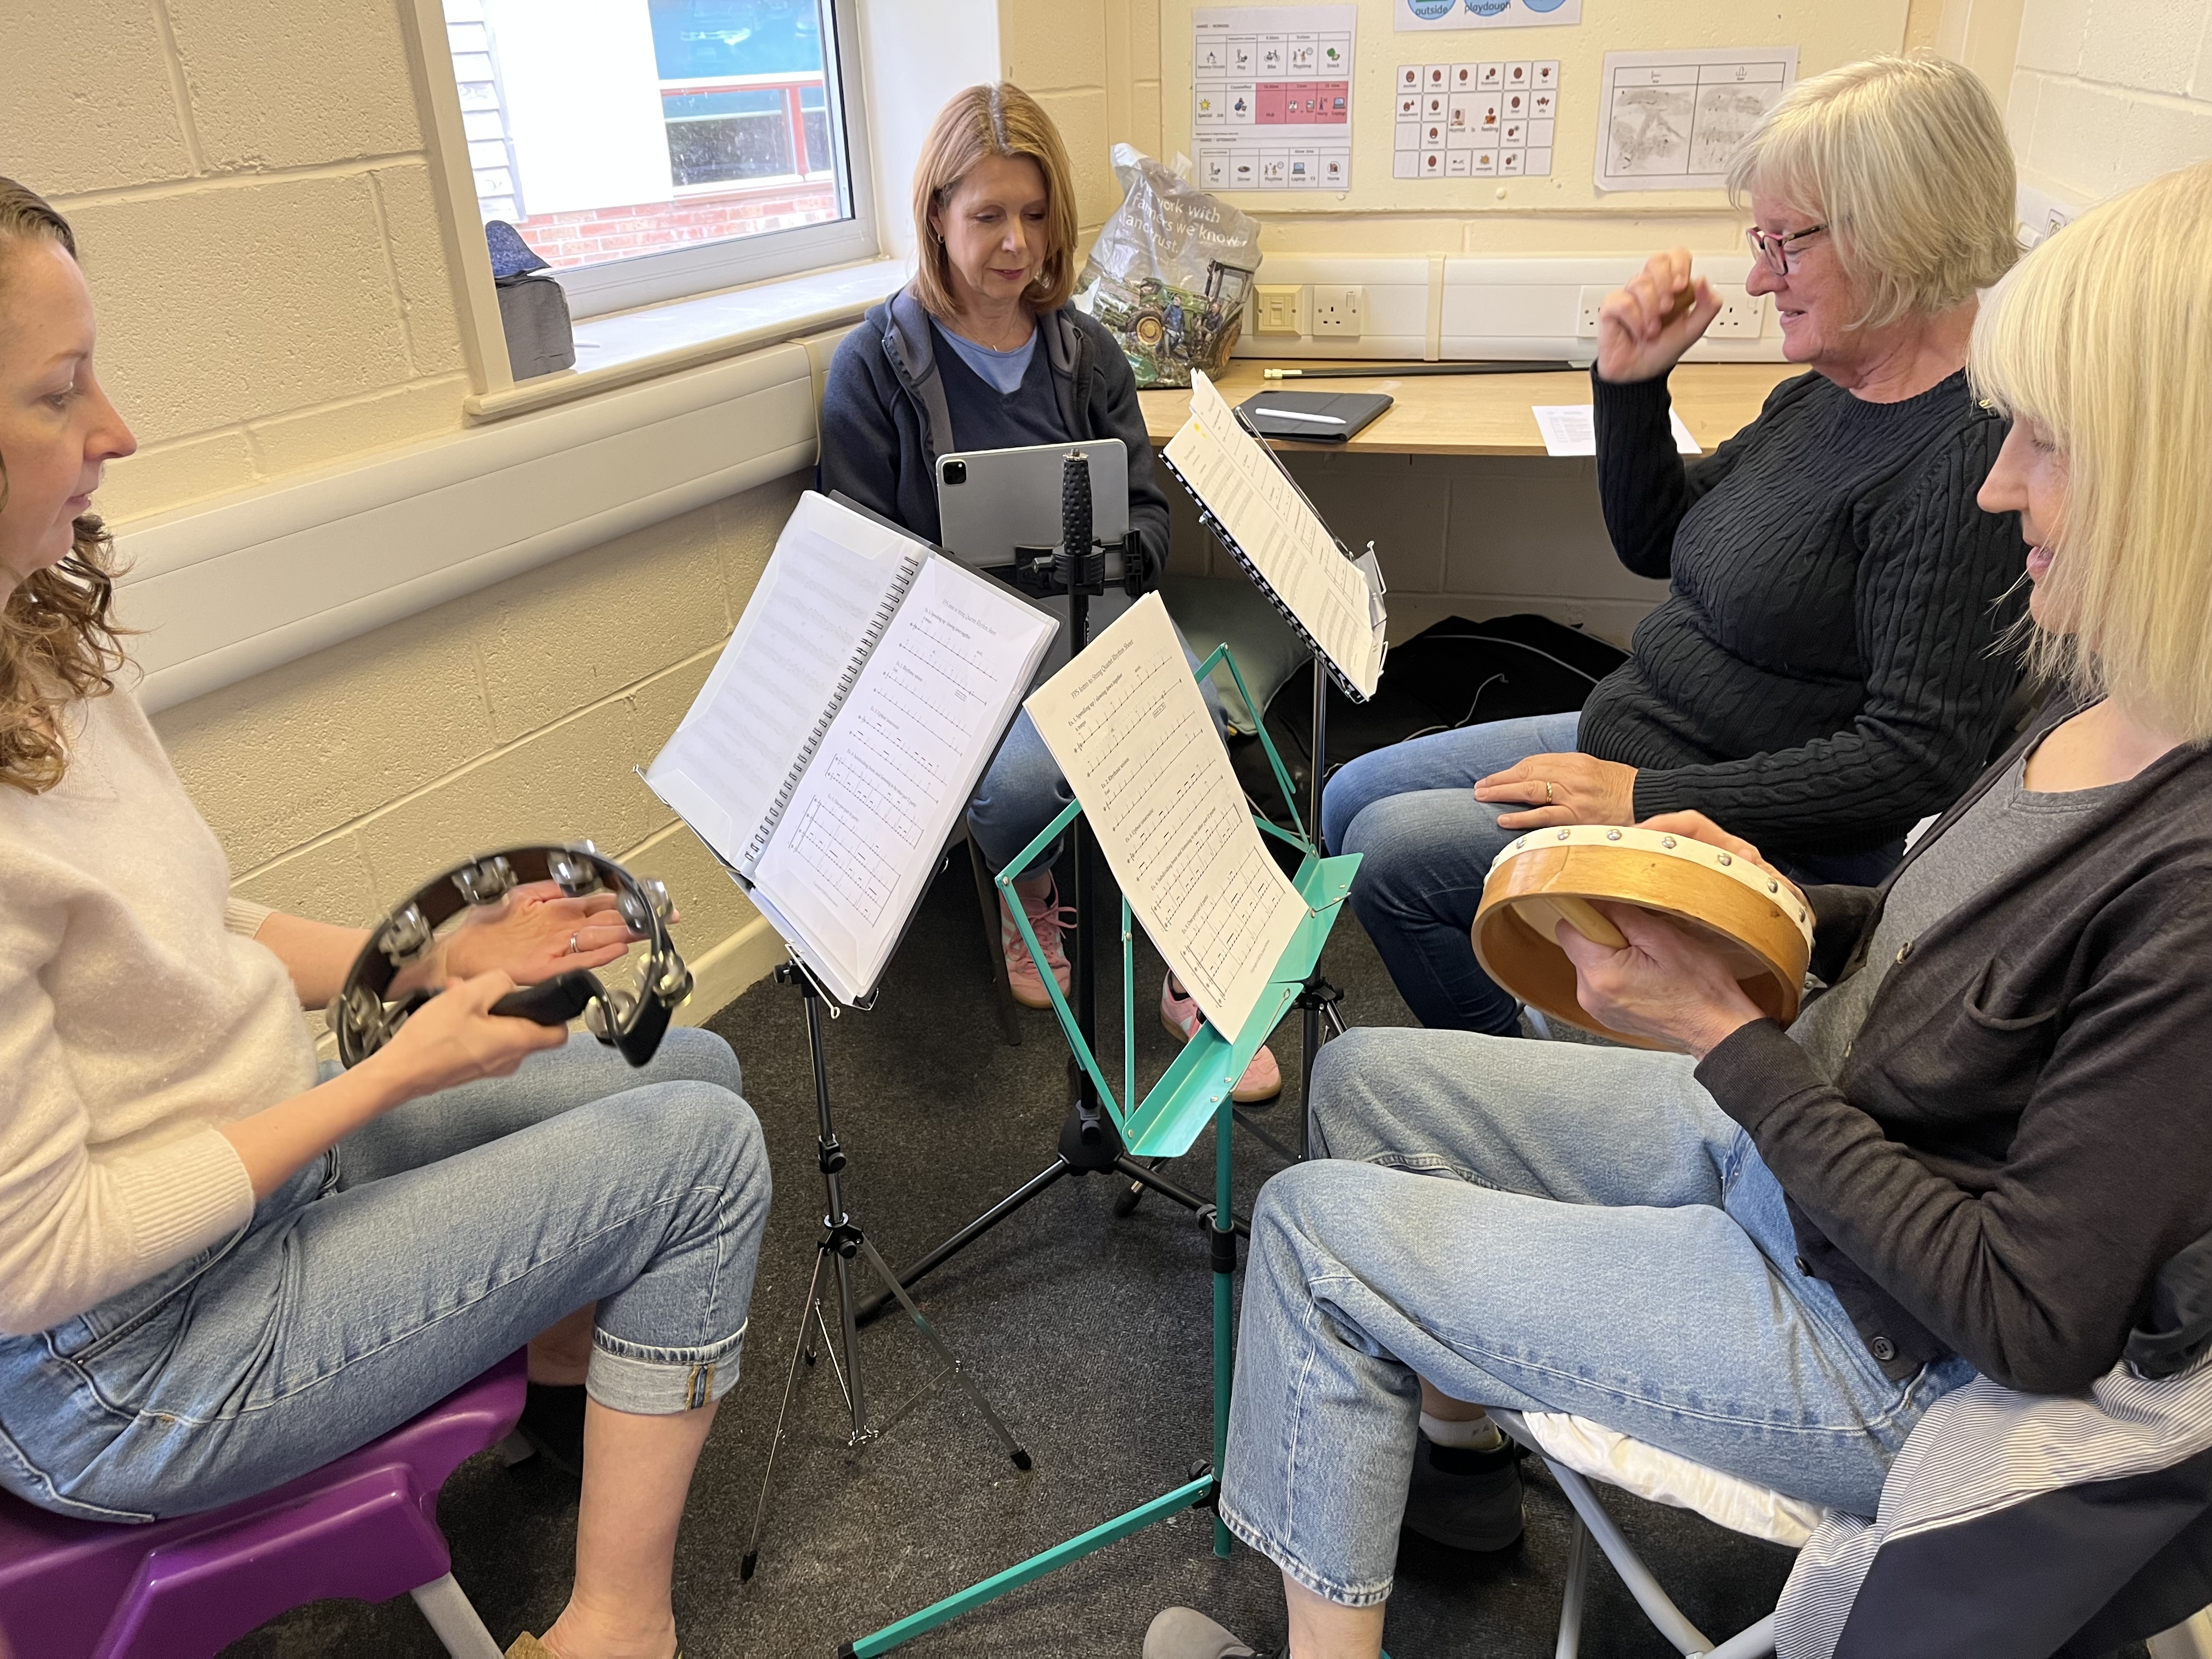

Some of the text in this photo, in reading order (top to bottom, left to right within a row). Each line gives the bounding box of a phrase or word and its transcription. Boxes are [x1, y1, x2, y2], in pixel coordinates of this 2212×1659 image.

[1415, 5, 1448, 15] outside
[1464, 1, 1511, 15] playdough
[1188, 204, 1220, 223] with
[1176, 222, 1195, 236] we
[1198, 223, 1239, 246] know
[1078, 680, 1089, 692] Intro
[1091, 668, 1103, 682] String
[1101, 657, 1114, 673] Quartet
[1111, 646, 1126, 663] Rhythm
[1122, 637, 1133, 650] Sheet
[1075, 703, 1091, 720] Speeding
[1094, 688, 1107, 703] slowing
[1105, 681, 1114, 691] down
[1111, 672, 1124, 686] together
[1107, 765, 1121, 782] Rhythmic
[1156, 862, 1172, 883] Subdividing
[1181, 837, 1192, 853] listening
[1186, 905, 1202, 927] One-per-part
